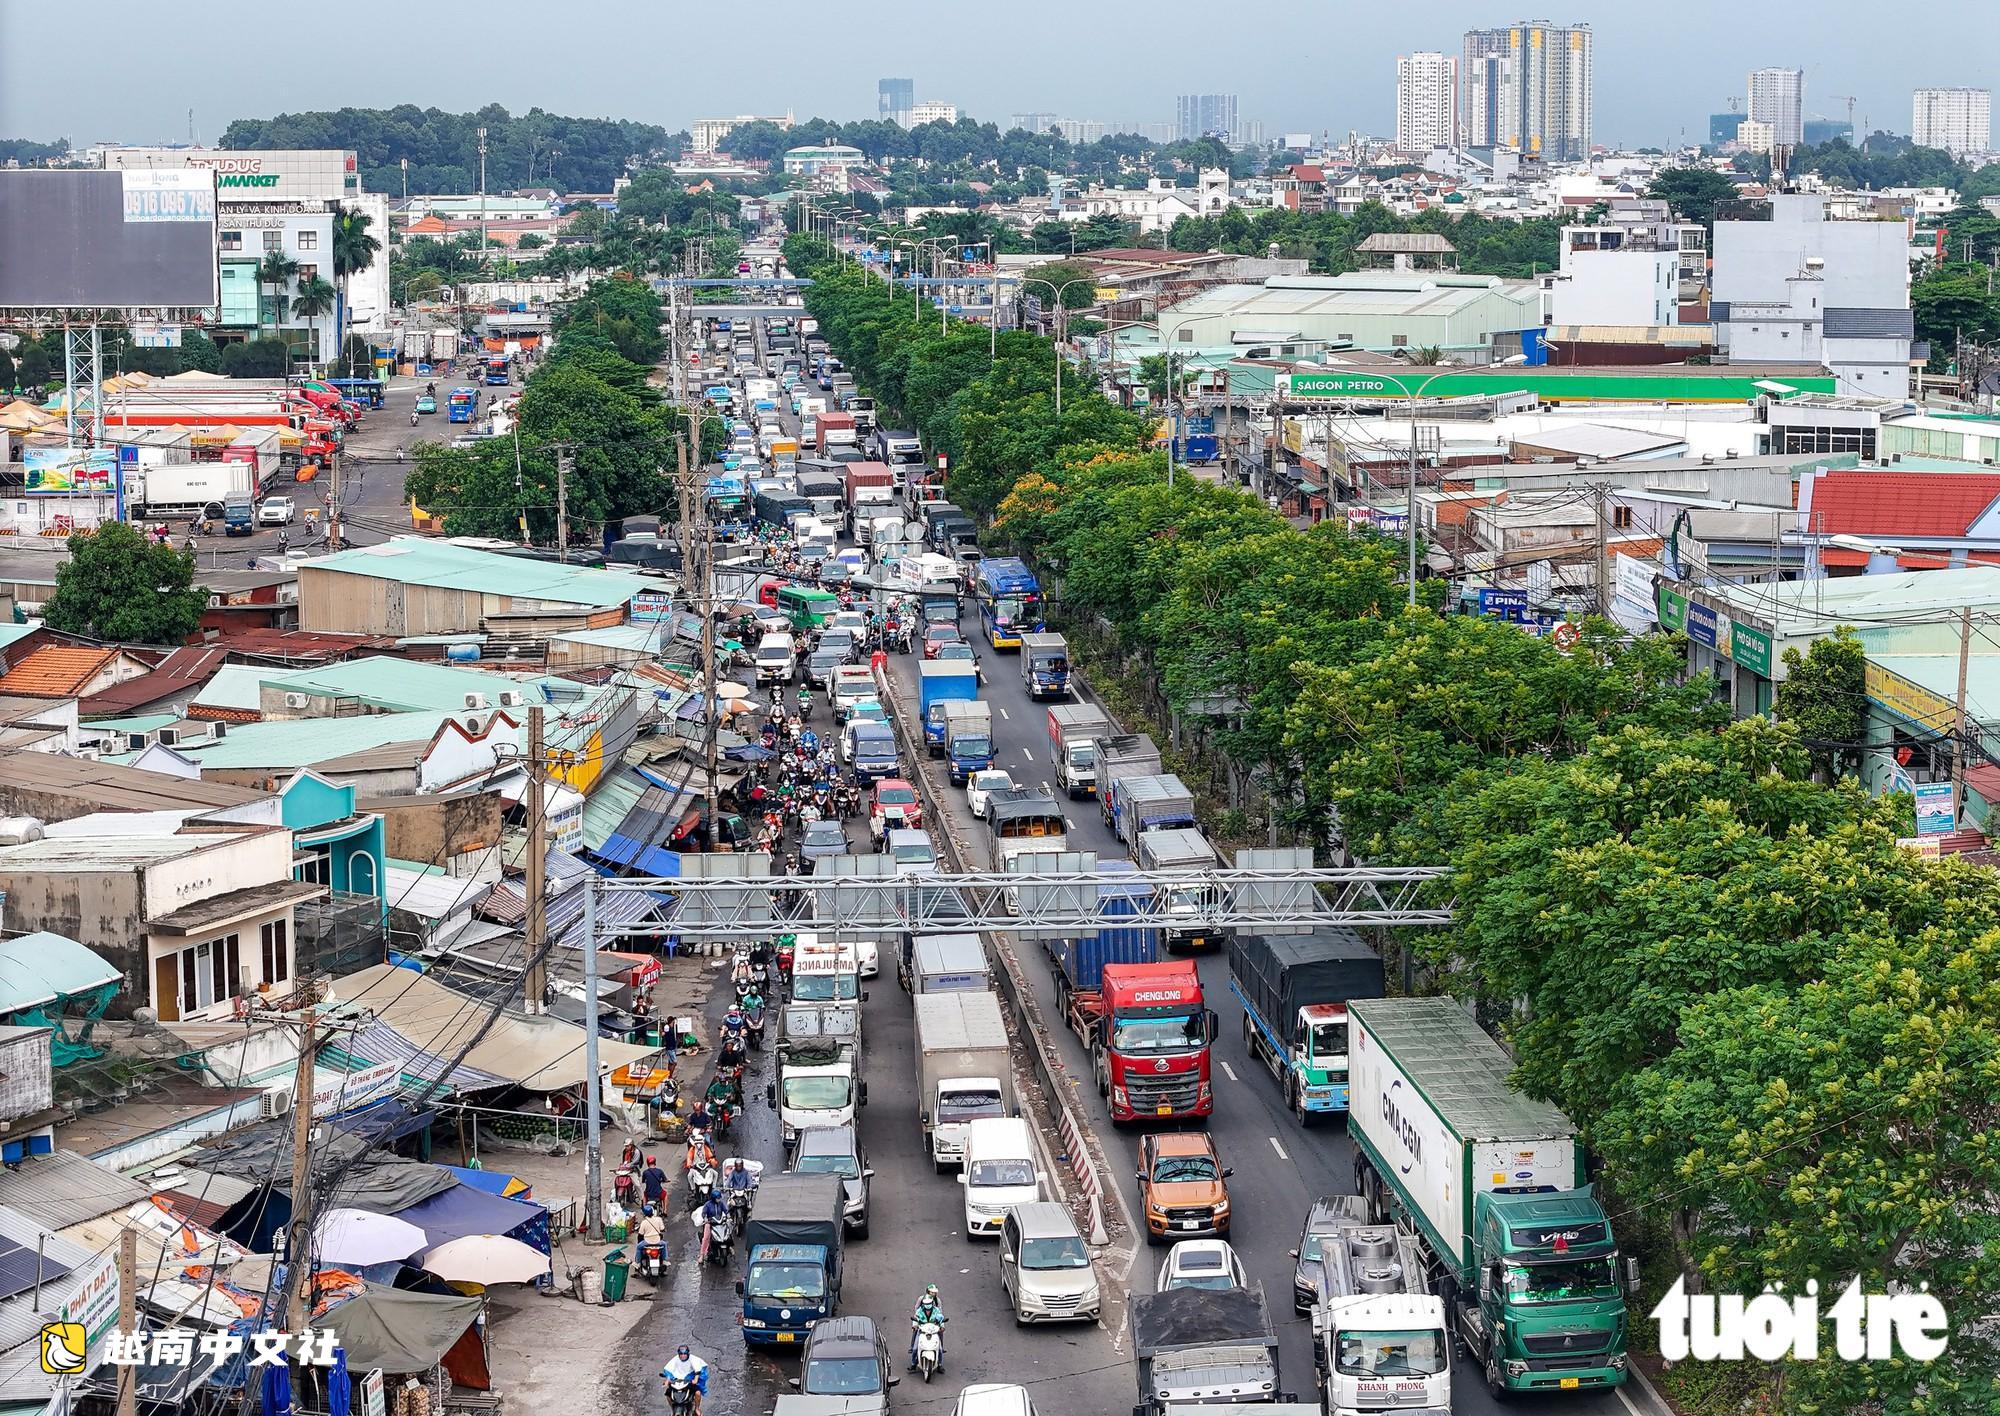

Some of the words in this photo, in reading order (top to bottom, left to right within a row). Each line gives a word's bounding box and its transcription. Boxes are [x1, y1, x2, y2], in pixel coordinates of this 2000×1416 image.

[218, 174, 280, 188] MARKET
[124, 191, 158, 214] 0916
[189, 191, 213, 214] 795
[264, 205, 285, 213] KINH
[288, 205, 323, 213] DOANH
[1297, 381, 1343, 390] SAIGON
[1347, 381, 1384, 390] PETRO
[1135, 991, 1181, 1001] CHENGLONG
[1383, 1092, 1401, 1138] CMA
[1402, 1116, 1422, 1165] CGM
[70, 1283, 92, 1317] PHÁT
[94, 1264, 111, 1293] ĐẠT
[1357, 1383, 1388, 1391] KHANH
[1396, 1382, 1425, 1390] PHONG
